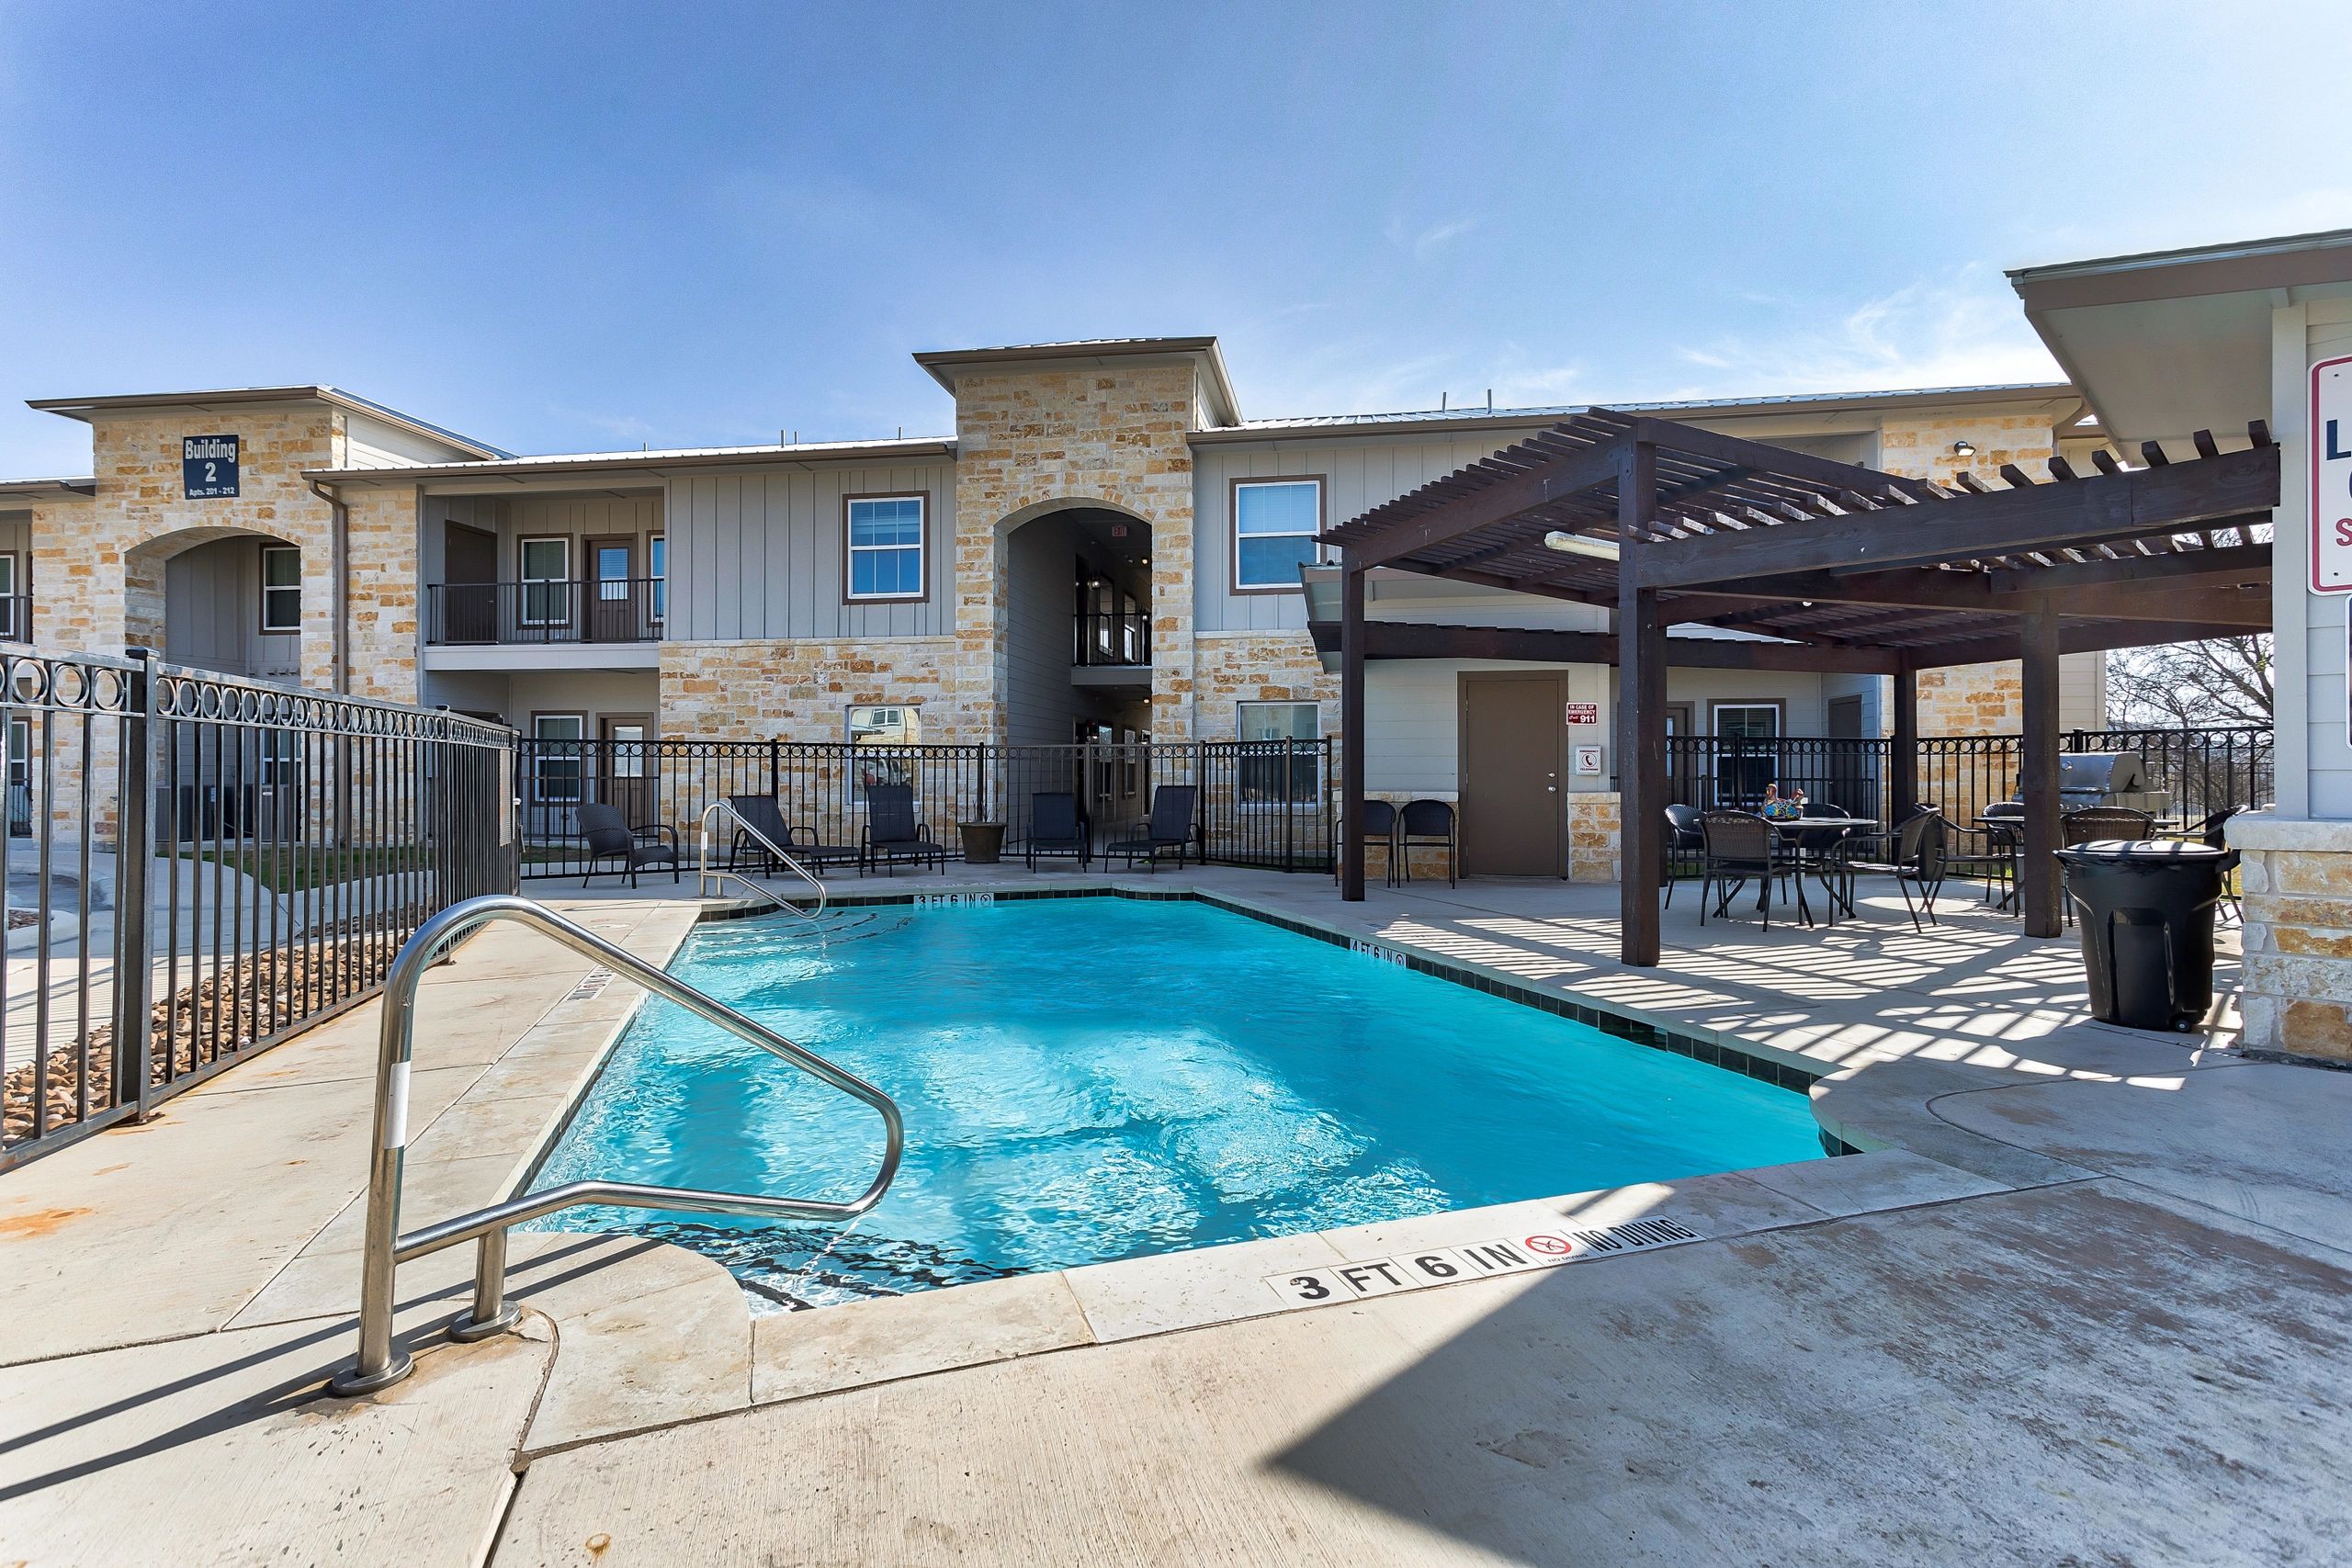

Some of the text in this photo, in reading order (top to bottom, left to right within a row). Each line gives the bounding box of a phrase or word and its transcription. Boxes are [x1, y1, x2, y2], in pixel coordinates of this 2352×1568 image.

[185, 438, 236, 463] Building
[205, 462, 217, 482] 2
[189, 488, 205, 497] Apts.
[206, 487, 218, 495] 201
[222, 486, 235, 495] 212
[1114, 526, 1125, 536] EXIT
[1580, 715, 1596, 723] 911
[950, 894, 958, 907] 6
[965, 893, 976, 907] IN
[1362, 942, 1371, 956] FT
[1374, 946, 1380, 959] 6
[1384, 948, 1393, 963] IN
[1572, 1219, 1698, 1252] NO DIVING
[1561, 1253, 1589, 1262] DIVING
[1289, 1244, 1529, 1300] 3 FT 6 IN
